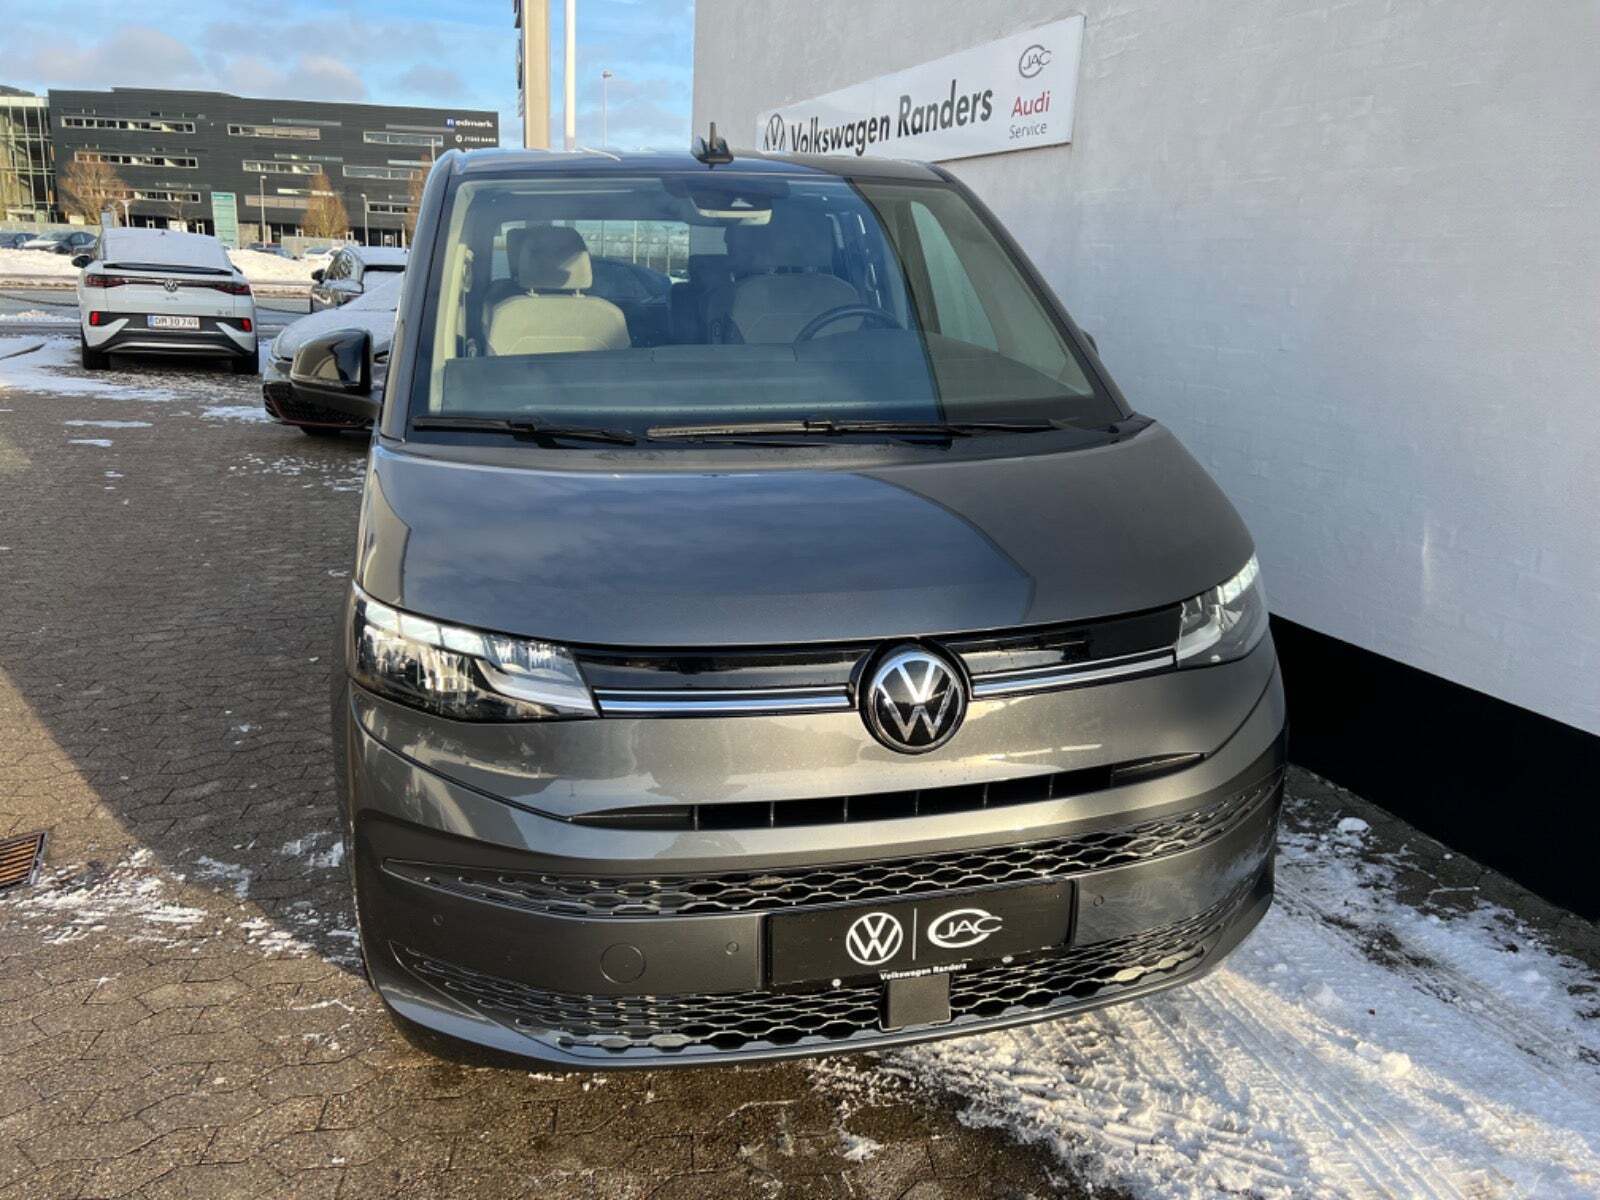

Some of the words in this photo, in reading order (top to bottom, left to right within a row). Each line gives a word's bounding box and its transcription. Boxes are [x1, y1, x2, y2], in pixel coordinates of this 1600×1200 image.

[1011, 91, 1050, 117] Audi
[791, 114, 890, 156] Volkswagen
[898, 79, 993, 138] Randers
[1009, 122, 1047, 140] Service
[880, 969, 931, 981] Volkswagen
[932, 963, 967, 973] Randers
